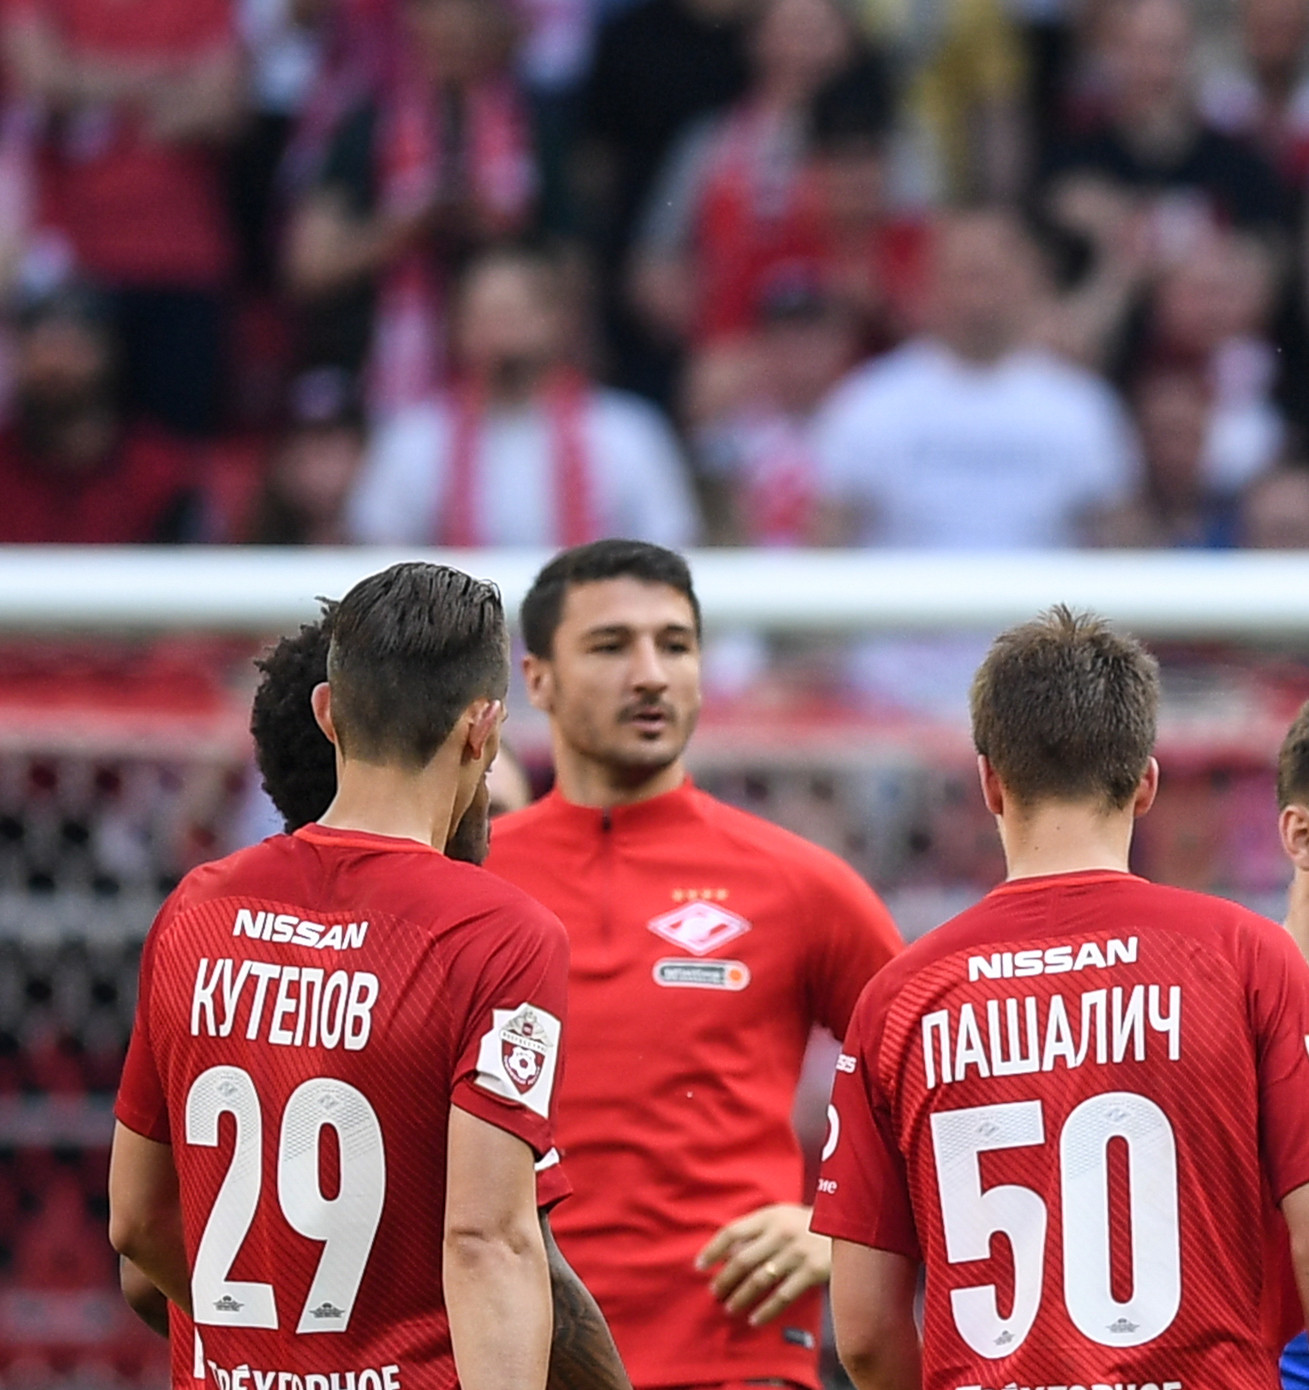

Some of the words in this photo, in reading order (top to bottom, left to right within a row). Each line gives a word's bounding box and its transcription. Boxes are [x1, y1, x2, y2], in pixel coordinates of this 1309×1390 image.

[233, 909, 368, 951] NISSAN
[968, 937, 1138, 981] NISSAN
[190, 957, 380, 1051] КУТЕПОВ
[921, 985, 1181, 1089] ПАШАЛИЧ
[184, 1065, 387, 1334] 29
[929, 1091, 1182, 1360] 50
